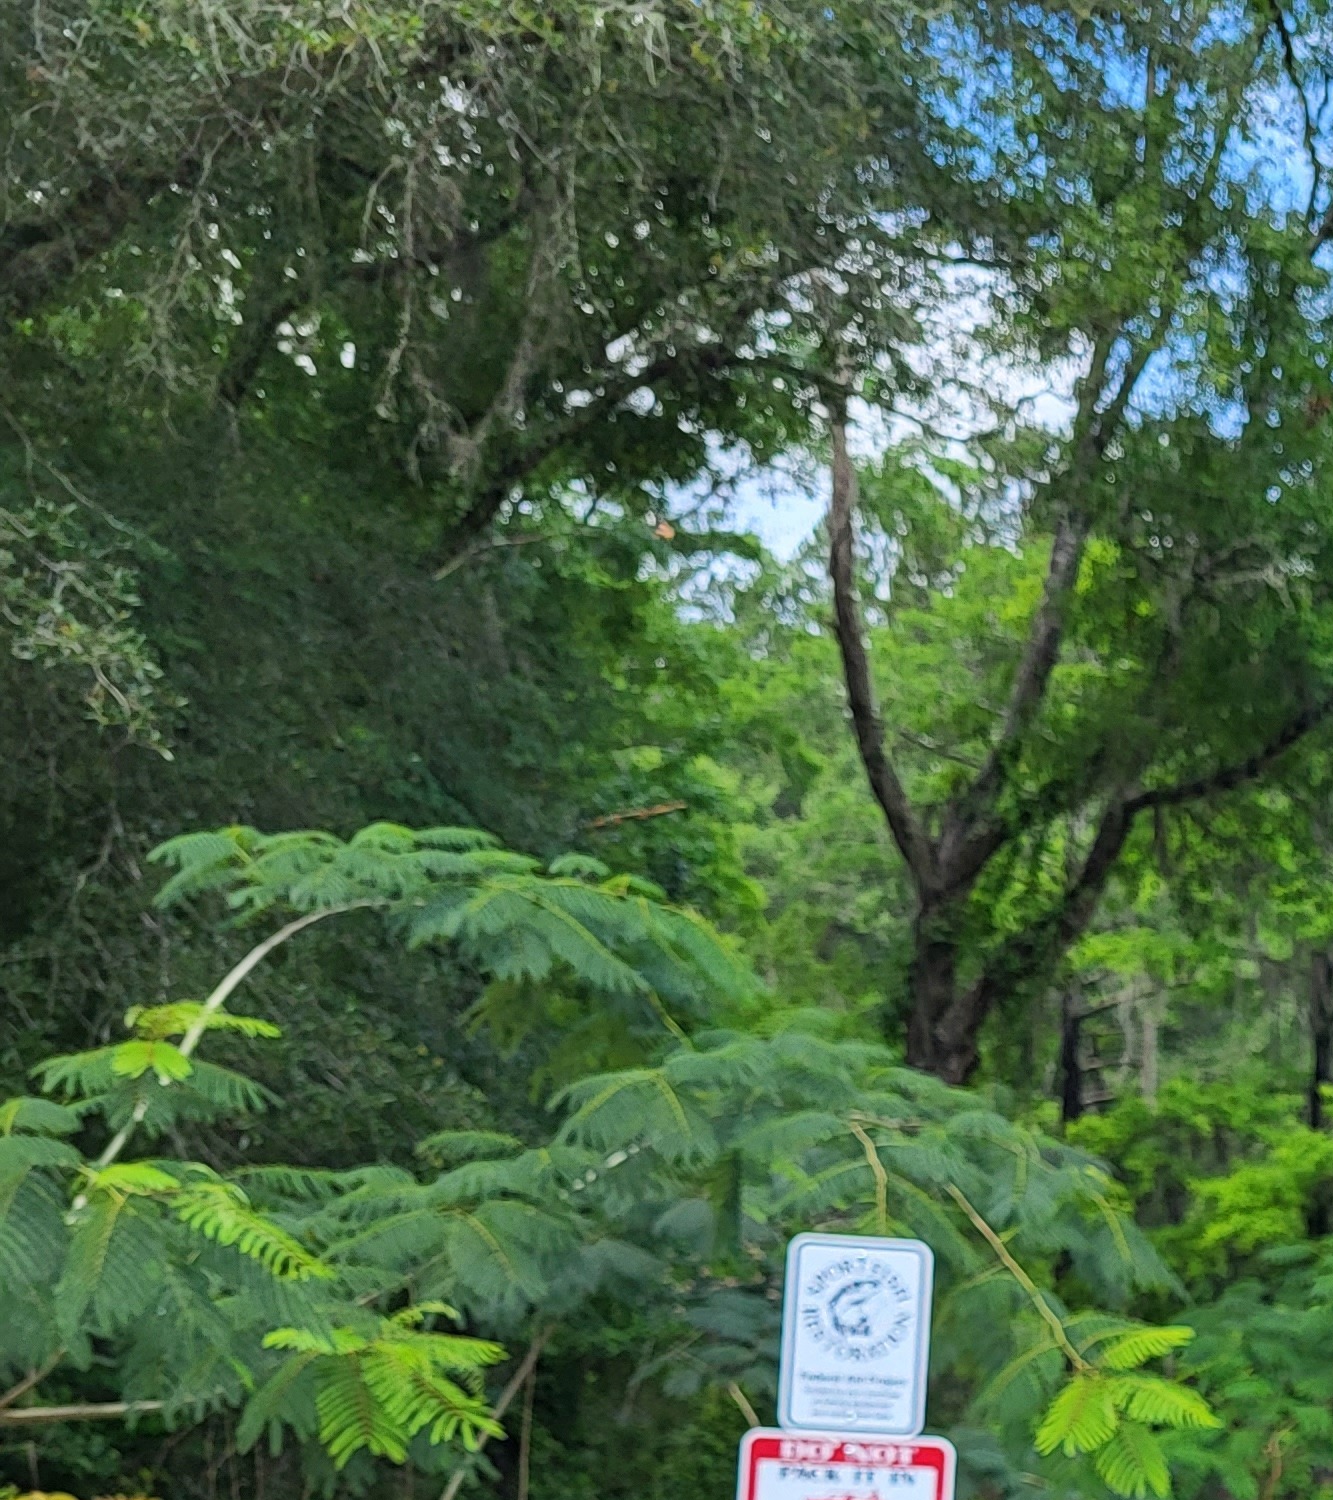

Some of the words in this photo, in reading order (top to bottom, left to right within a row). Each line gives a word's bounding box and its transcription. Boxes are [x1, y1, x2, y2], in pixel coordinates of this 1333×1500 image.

[780, 1439, 835, 1462] DO
[843, 1444, 919, 1466] NOT
[779, 1467, 840, 1482] PACK
[853, 1470, 875, 1483] IT
